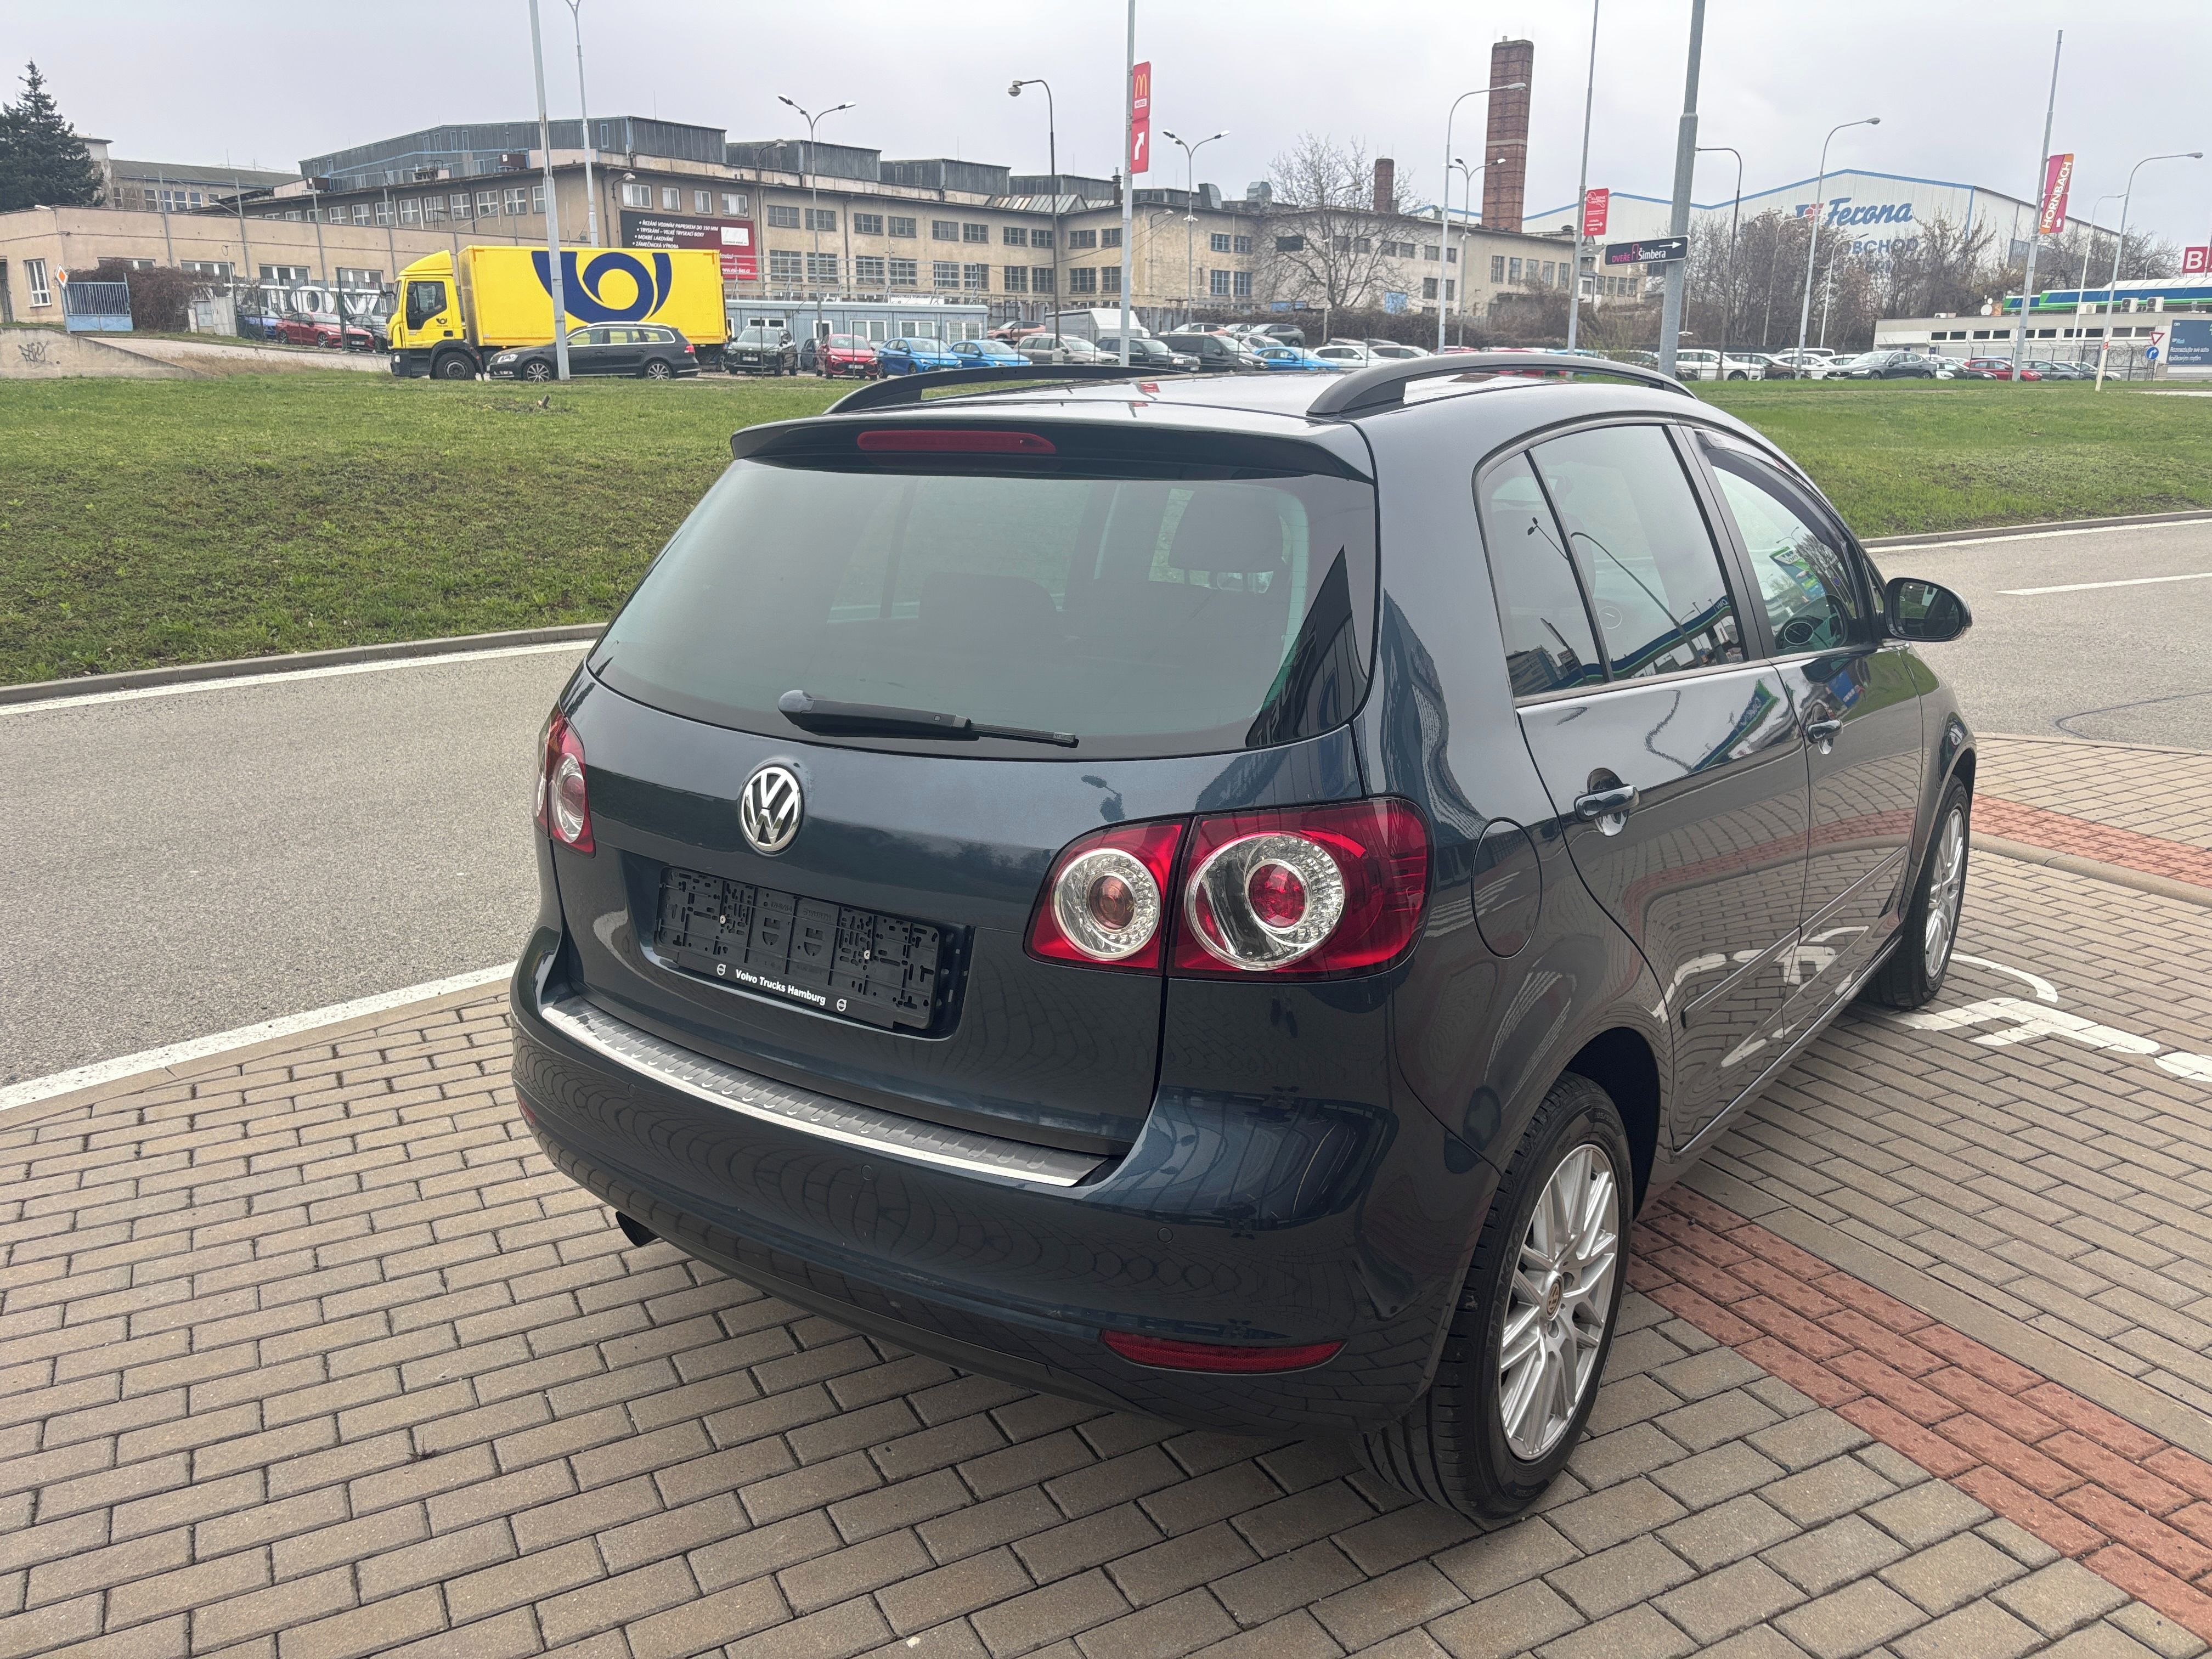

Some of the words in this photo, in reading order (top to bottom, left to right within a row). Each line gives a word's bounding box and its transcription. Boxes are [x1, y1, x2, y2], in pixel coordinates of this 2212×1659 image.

[2042, 161, 2072, 228] HORNBACH
[1825, 198, 1913, 227] Ferona
[1612, 252, 1630, 263] DVEŘE
[1638, 247, 1666, 260] Šimbera
[736, 969, 758, 984] Volvo
[759, 976, 786, 992] Trucks
[787, 984, 826, 1006] Hamburg
